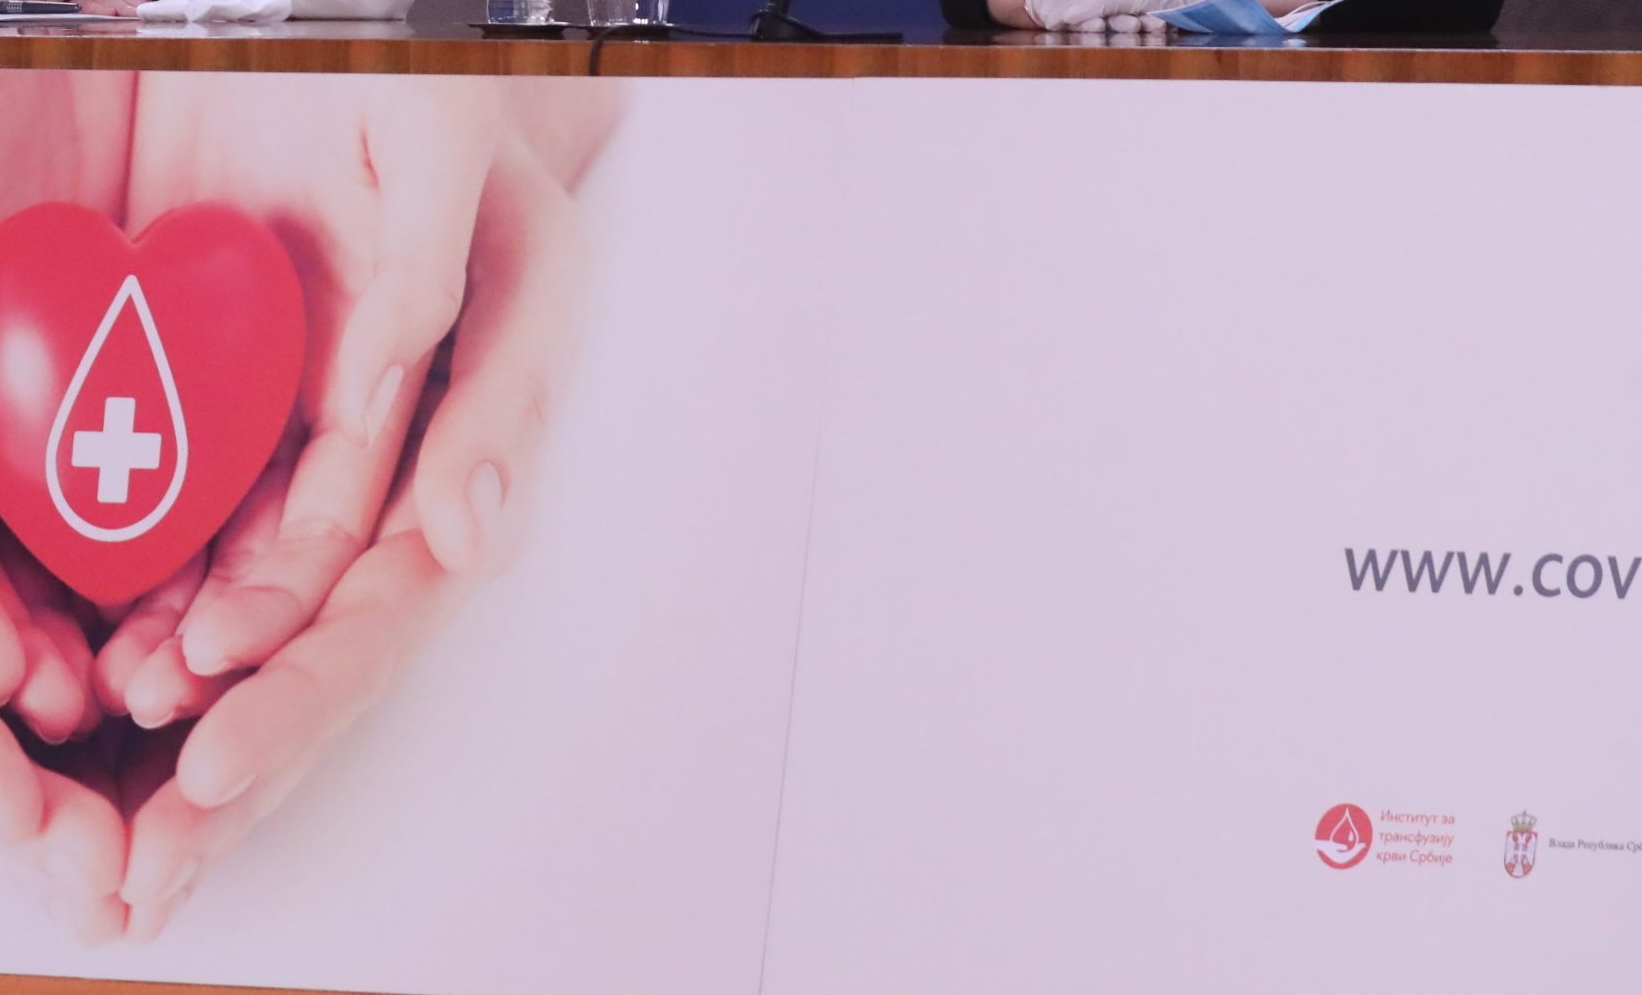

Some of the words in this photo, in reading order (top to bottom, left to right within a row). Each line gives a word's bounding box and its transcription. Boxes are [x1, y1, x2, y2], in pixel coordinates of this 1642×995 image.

[1381, 809, 1439, 826] Институт
[1441, 815, 1456, 825] за
[1379, 831, 1455, 847] трансфузију
[1548, 838, 1575, 850] Влада
[1376, 850, 1407, 864] крви
[1409, 849, 1453, 866] Србије
